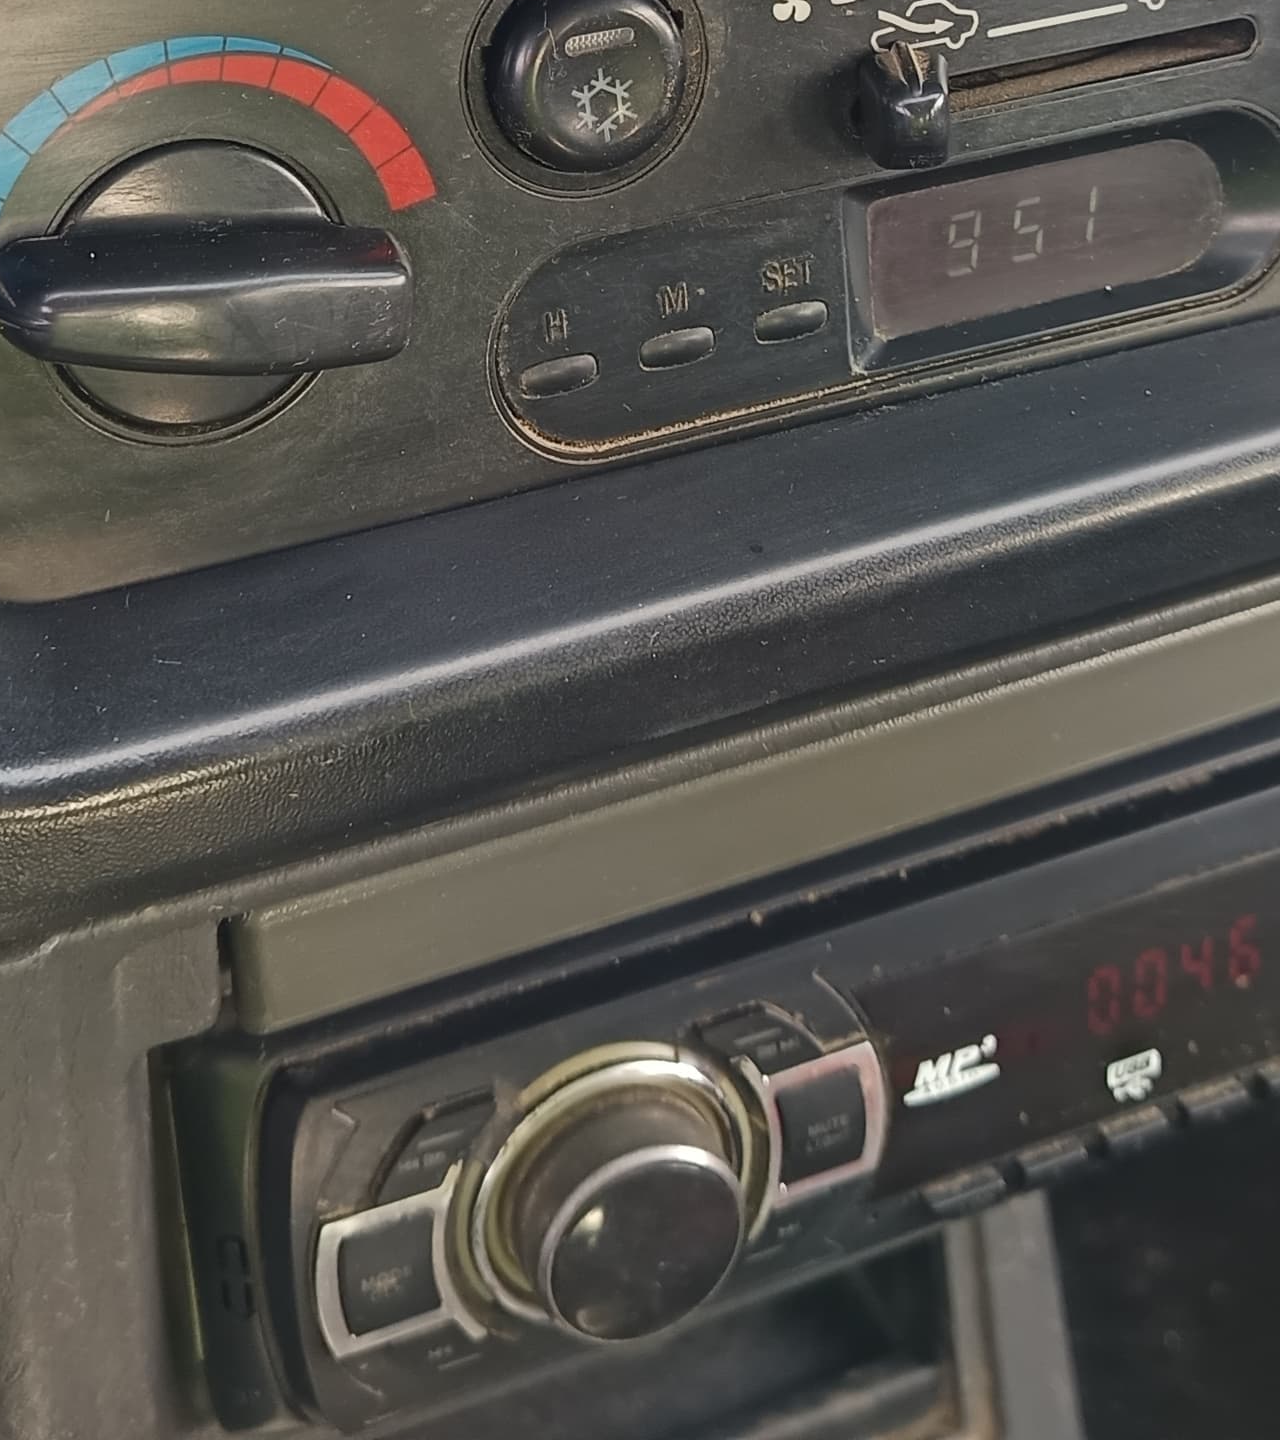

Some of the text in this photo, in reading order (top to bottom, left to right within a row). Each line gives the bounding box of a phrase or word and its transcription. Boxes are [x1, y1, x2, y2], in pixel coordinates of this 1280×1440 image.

[761, 254, 816, 295] SET
[655, 280, 690, 318] M
[544, 309, 569, 344] H
